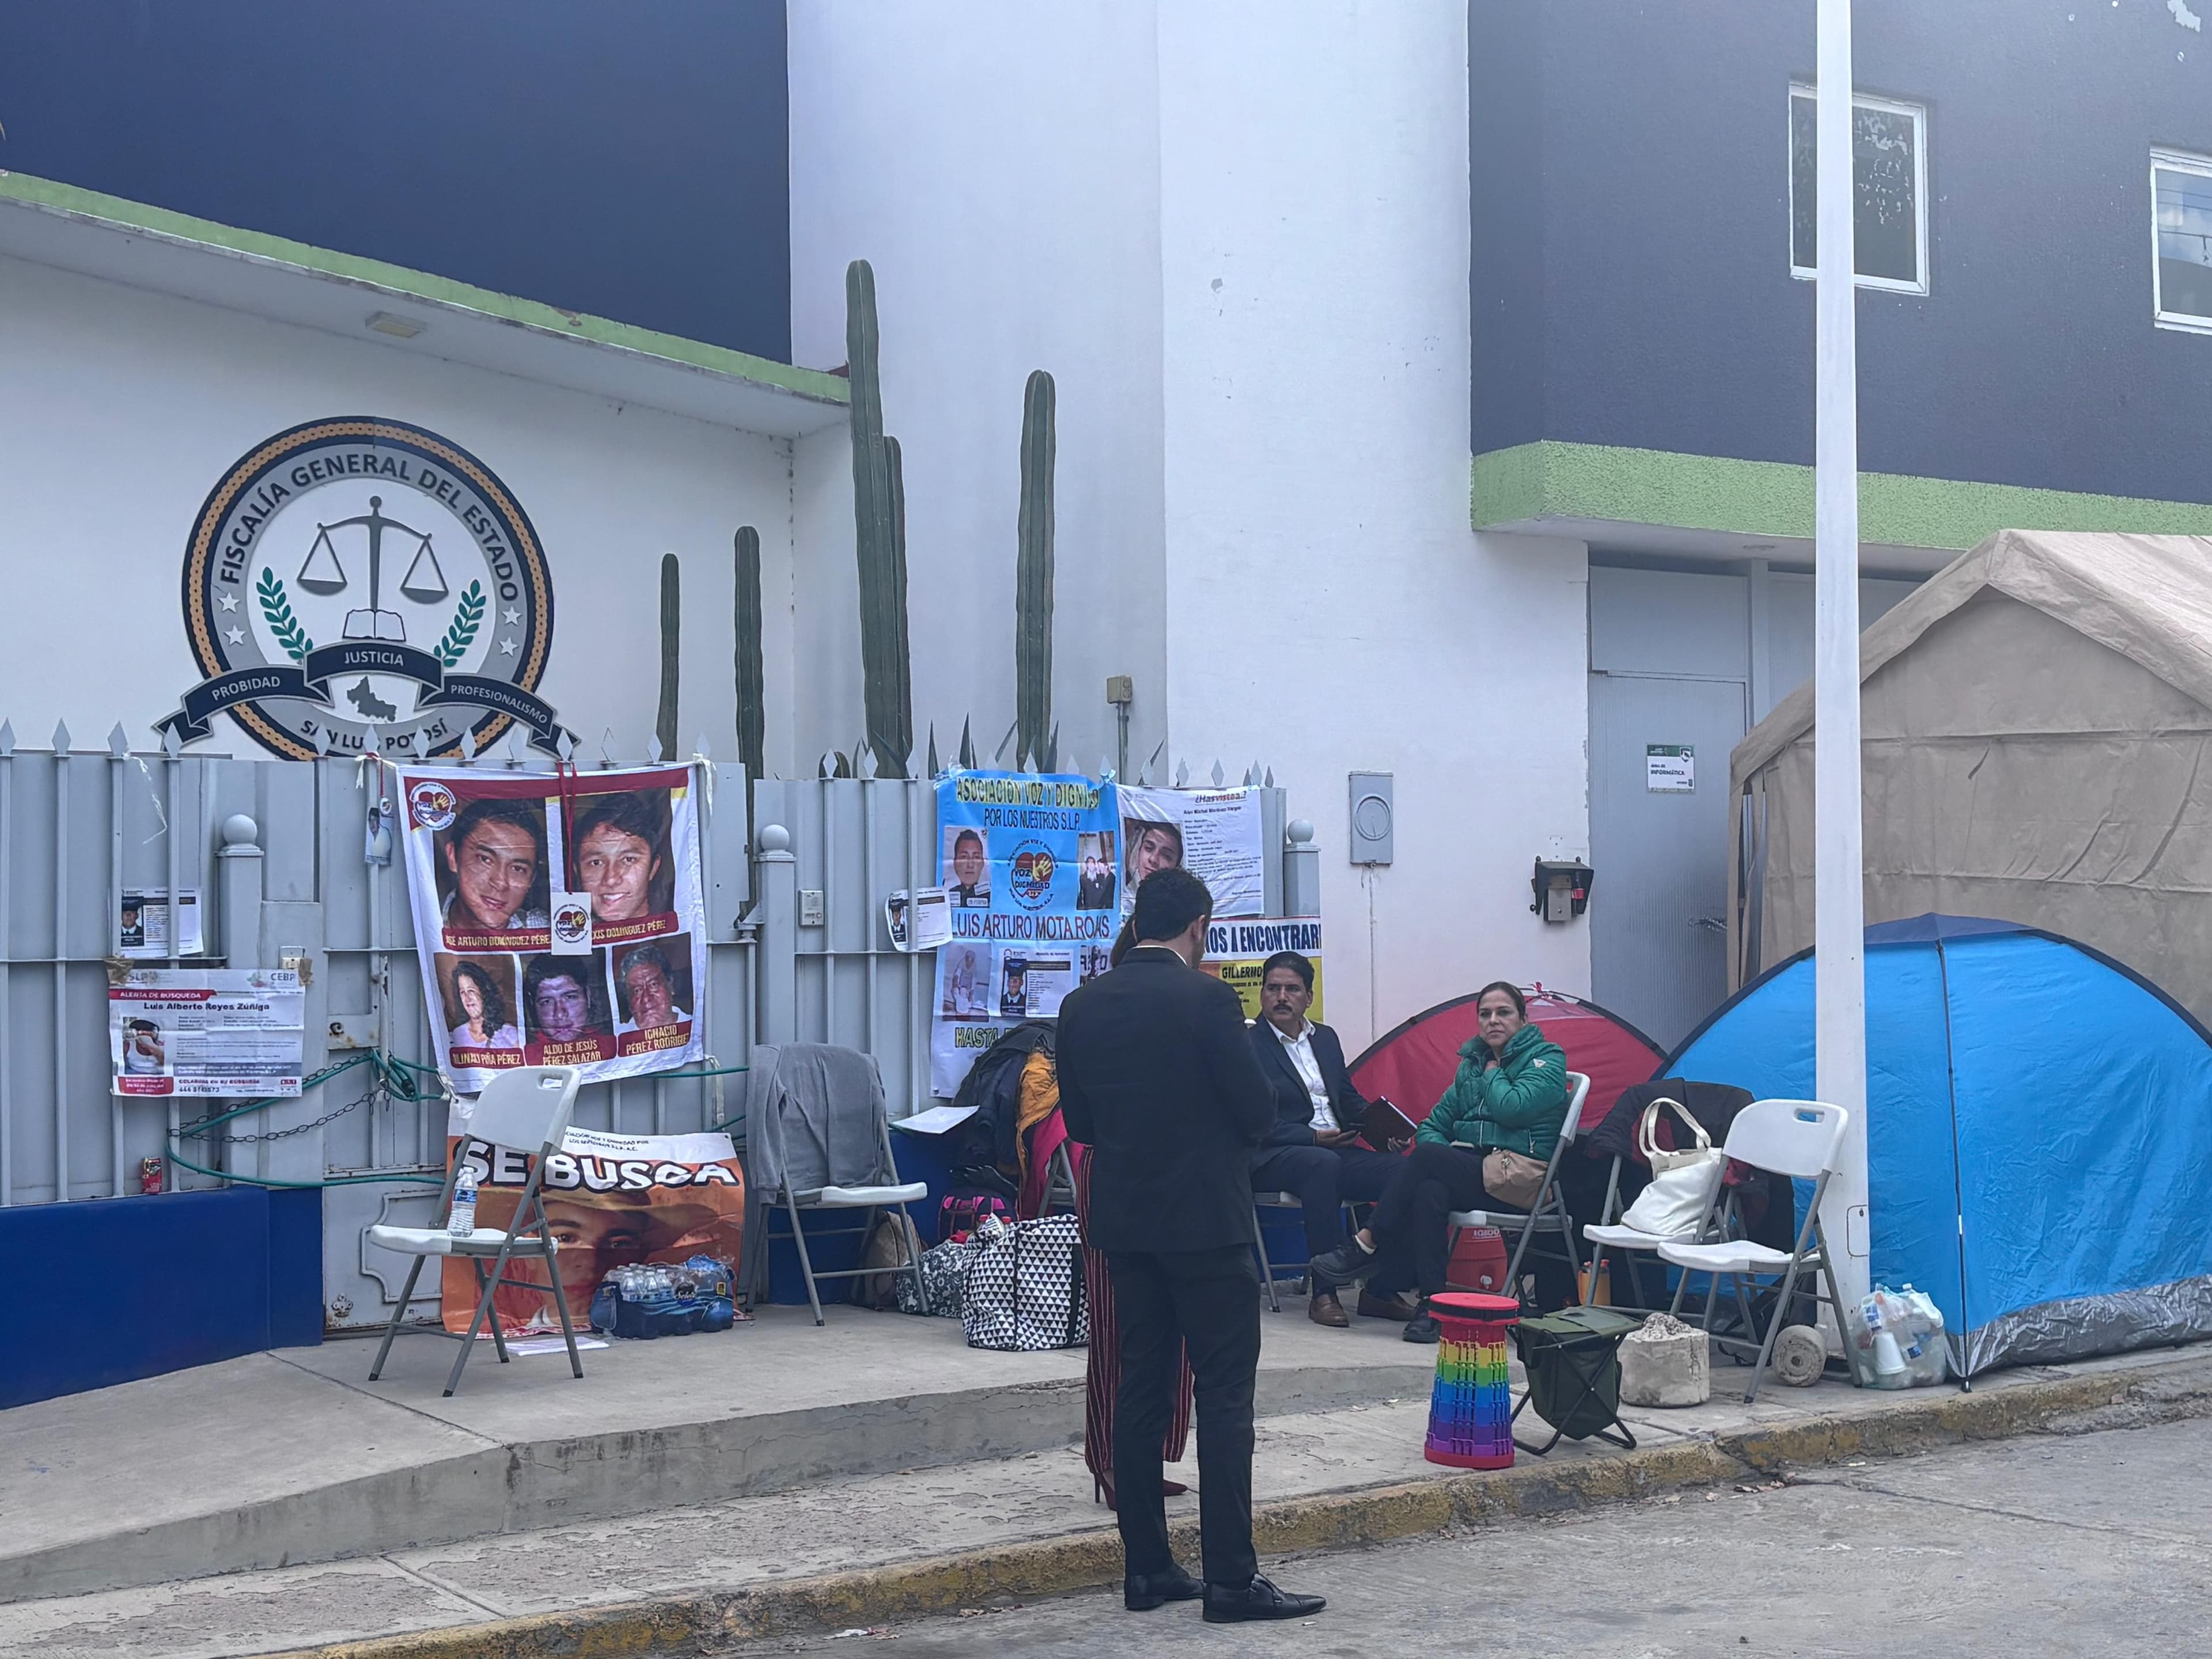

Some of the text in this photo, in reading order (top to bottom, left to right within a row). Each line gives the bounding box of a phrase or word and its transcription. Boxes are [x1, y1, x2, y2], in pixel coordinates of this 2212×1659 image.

[220, 453, 519, 602] FISCALÍA GENERAL DEL ESTADO
[344, 650, 404, 668] JUSTICIA
[211, 675, 281, 701] PROBIDAD
[450, 684, 548, 725] PROFESIONALISMO
[342, 734, 381, 749] LU
[956, 776, 1022, 805] ASOCIACIÓN
[1024, 781, 1043, 806] VOZ
[1046, 782, 1053, 807] Y
[984, 808, 1002, 828] POR
[1002, 809, 1018, 828] LOS
[1020, 810, 1059, 831] NUESTROS
[982, 914, 1032, 939] ARTURO
[1036, 916, 1075, 940] MOTA
[457, 935, 488, 946] ARTURO
[531, 934, 552, 945] PÉRE
[1239, 923, 1322, 952] ENCONTRAR
[143, 1002, 164, 1010] Luis
[205, 1003, 235, 1012] Reyes
[237, 1002, 270, 1012] Zúñiga
[644, 1024, 677, 1040] IGNACIO
[543, 1037, 598, 1055] ALDO DE JESÚS
[626, 1040, 653, 1055] PÉREZ
[497, 1051, 521, 1065] PÉREZ
[543, 1051, 602, 1066] PÉREZ SALAZAR
[458, 1138, 741, 1194] SE BUSCA
